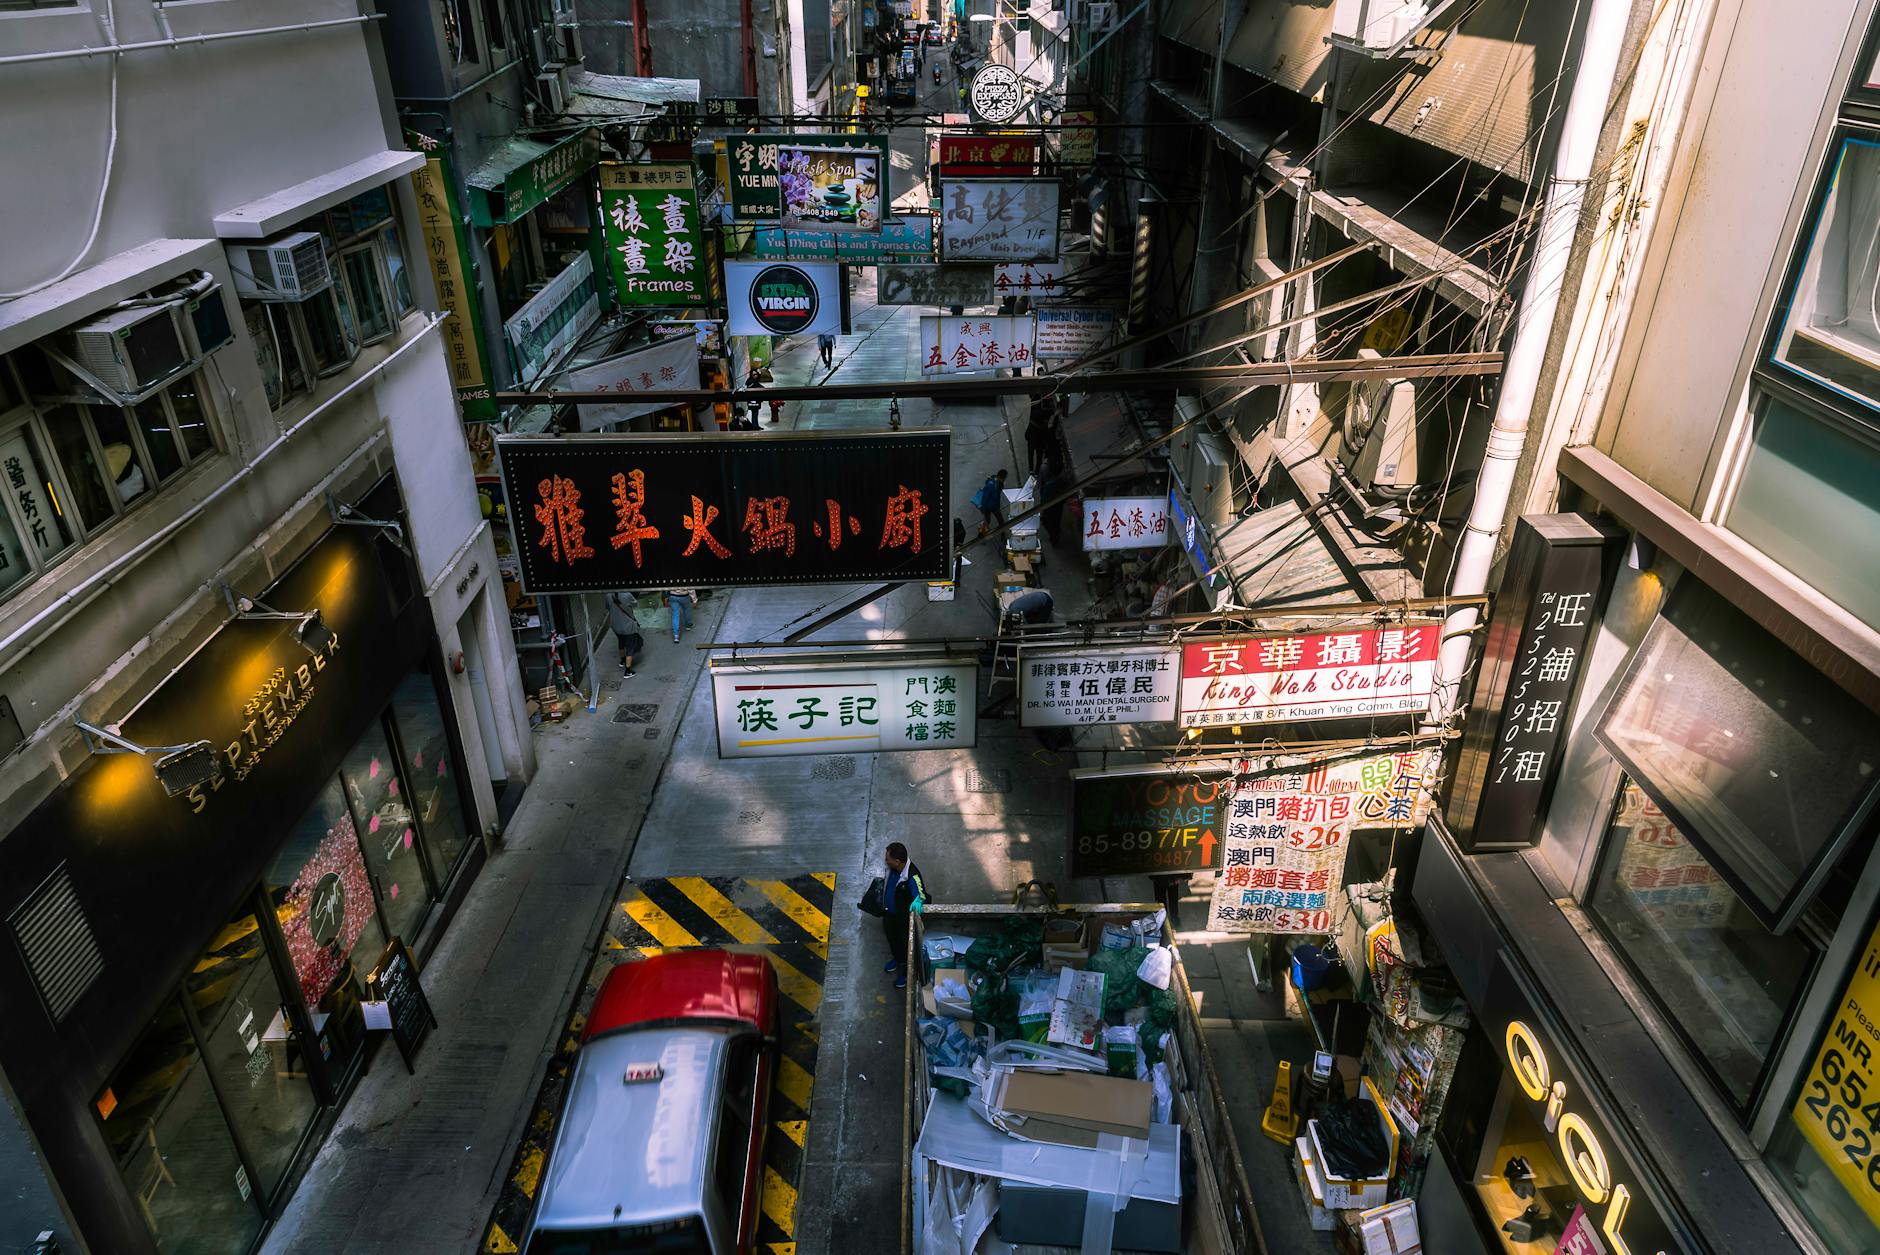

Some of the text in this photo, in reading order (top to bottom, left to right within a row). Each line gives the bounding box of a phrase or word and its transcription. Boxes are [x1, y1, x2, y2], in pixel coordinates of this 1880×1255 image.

[977, 93, 1016, 101] EXPRESS
[984, 85, 1009, 93] PIZZA
[944, 146, 984, 164] 北京
[787, 160, 852, 180] Fresh Spa
[738, 175, 760, 187] YUE
[821, 208, 838, 216] 1849
[767, 238, 786, 248] Yue
[787, 238, 817, 249] Ming
[820, 238, 847, 249] Glass
[850, 239, 868, 249] and
[871, 240, 910, 250] Frames
[949, 226, 1008, 252] Raymond
[1026, 228, 1047, 241] 1/F
[627, 278, 694, 292] Frames
[761, 283, 806, 297] EXTRA
[757, 297, 810, 310] VIRGIN
[1038, 309, 1072, 322] Universal
[1073, 310, 1094, 323] Cyber
[924, 341, 1031, 369] 五金漆油
[1086, 507, 1166, 539] 五金漆油
[1540, 593, 1556, 604] Tel
[1201, 628, 1422, 673] 京華攝影
[1032, 659, 1170, 677] 菲律賓東方大學牙科博士
[1079, 677, 1153, 697] 伍偉民
[1202, 667, 1413, 705] King Wah Studio
[1512, 592, 1591, 783] 旺舖招租
[1028, 696, 1170, 709] DR. NG WAI MAN DENTAL SURGEON
[1266, 709, 1285, 718] 8/F
[1290, 706, 1324, 717] Khuan
[1330, 704, 1353, 715] Ying
[1357, 702, 1394, 712] Comm.
[1399, 699, 1422, 710] Bldg
[188, 632, 340, 814] SEPTEMBER
[265, 686, 315, 748] RESTAURANT
[737, 696, 879, 732] 筷子記
[1078, 715, 1095, 723] 4/F
[1127, 780, 1218, 806] YOYO
[1114, 806, 1214, 829] MASSAGE
[1233, 796, 1350, 822] 澳門豬扒包
[1079, 828, 1198, 854] 85-89 7/F
[1228, 823, 1341, 849] 送熱飲 $26
[1227, 847, 1274, 866] 澳門
[1225, 868, 1329, 891] 撈麵套餐
[1217, 905, 1330, 932] 送熱飲 $30
[1835, 1019, 1873, 1076] MR.
